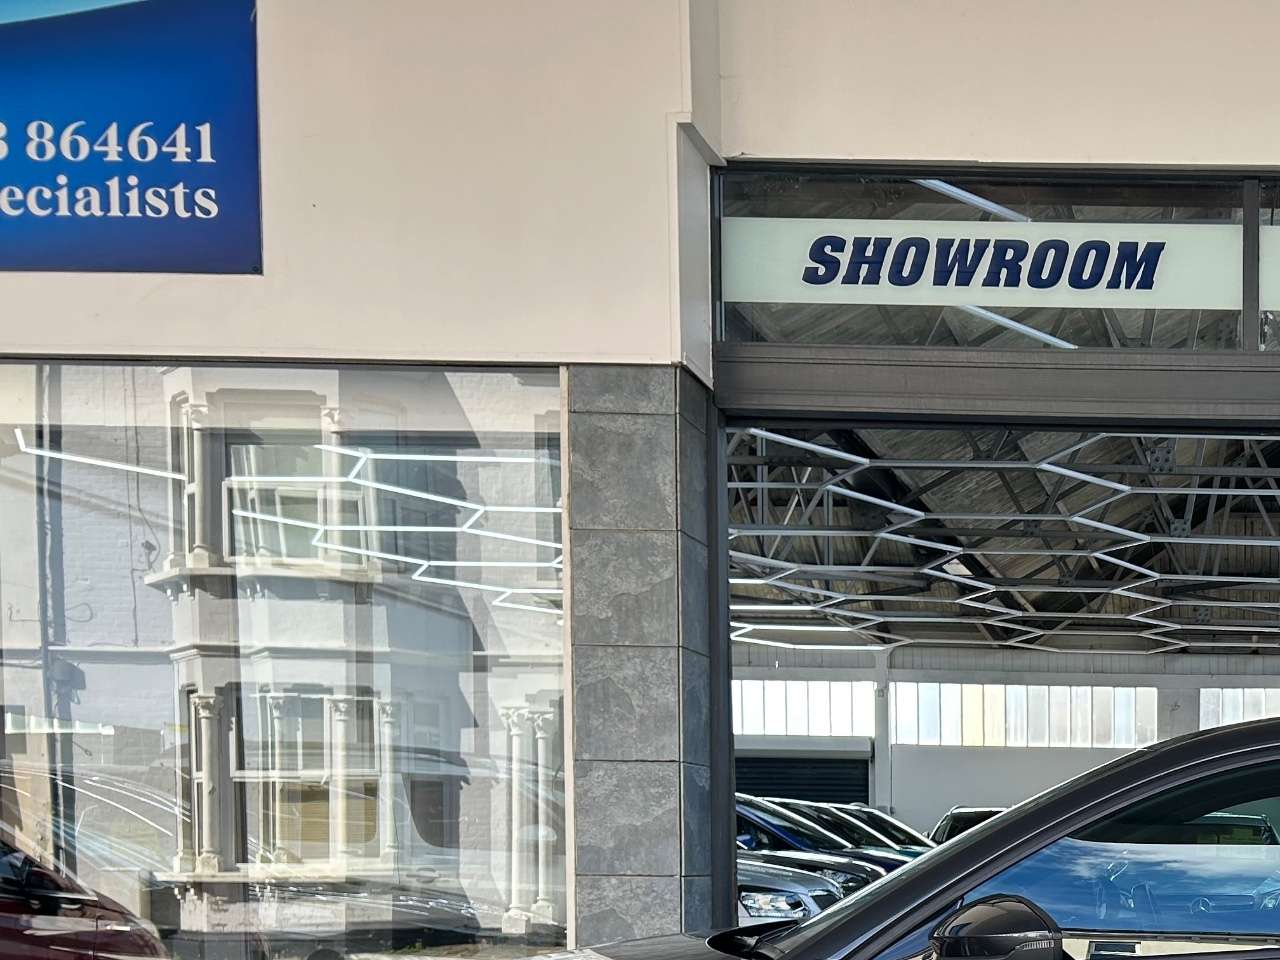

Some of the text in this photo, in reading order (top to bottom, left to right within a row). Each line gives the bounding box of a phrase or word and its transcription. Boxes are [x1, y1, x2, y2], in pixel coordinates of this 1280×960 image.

[26, 121, 216, 163] 864641
[0, 174, 219, 219] ecialists
[801, 235, 1167, 290] SHOWROOM
